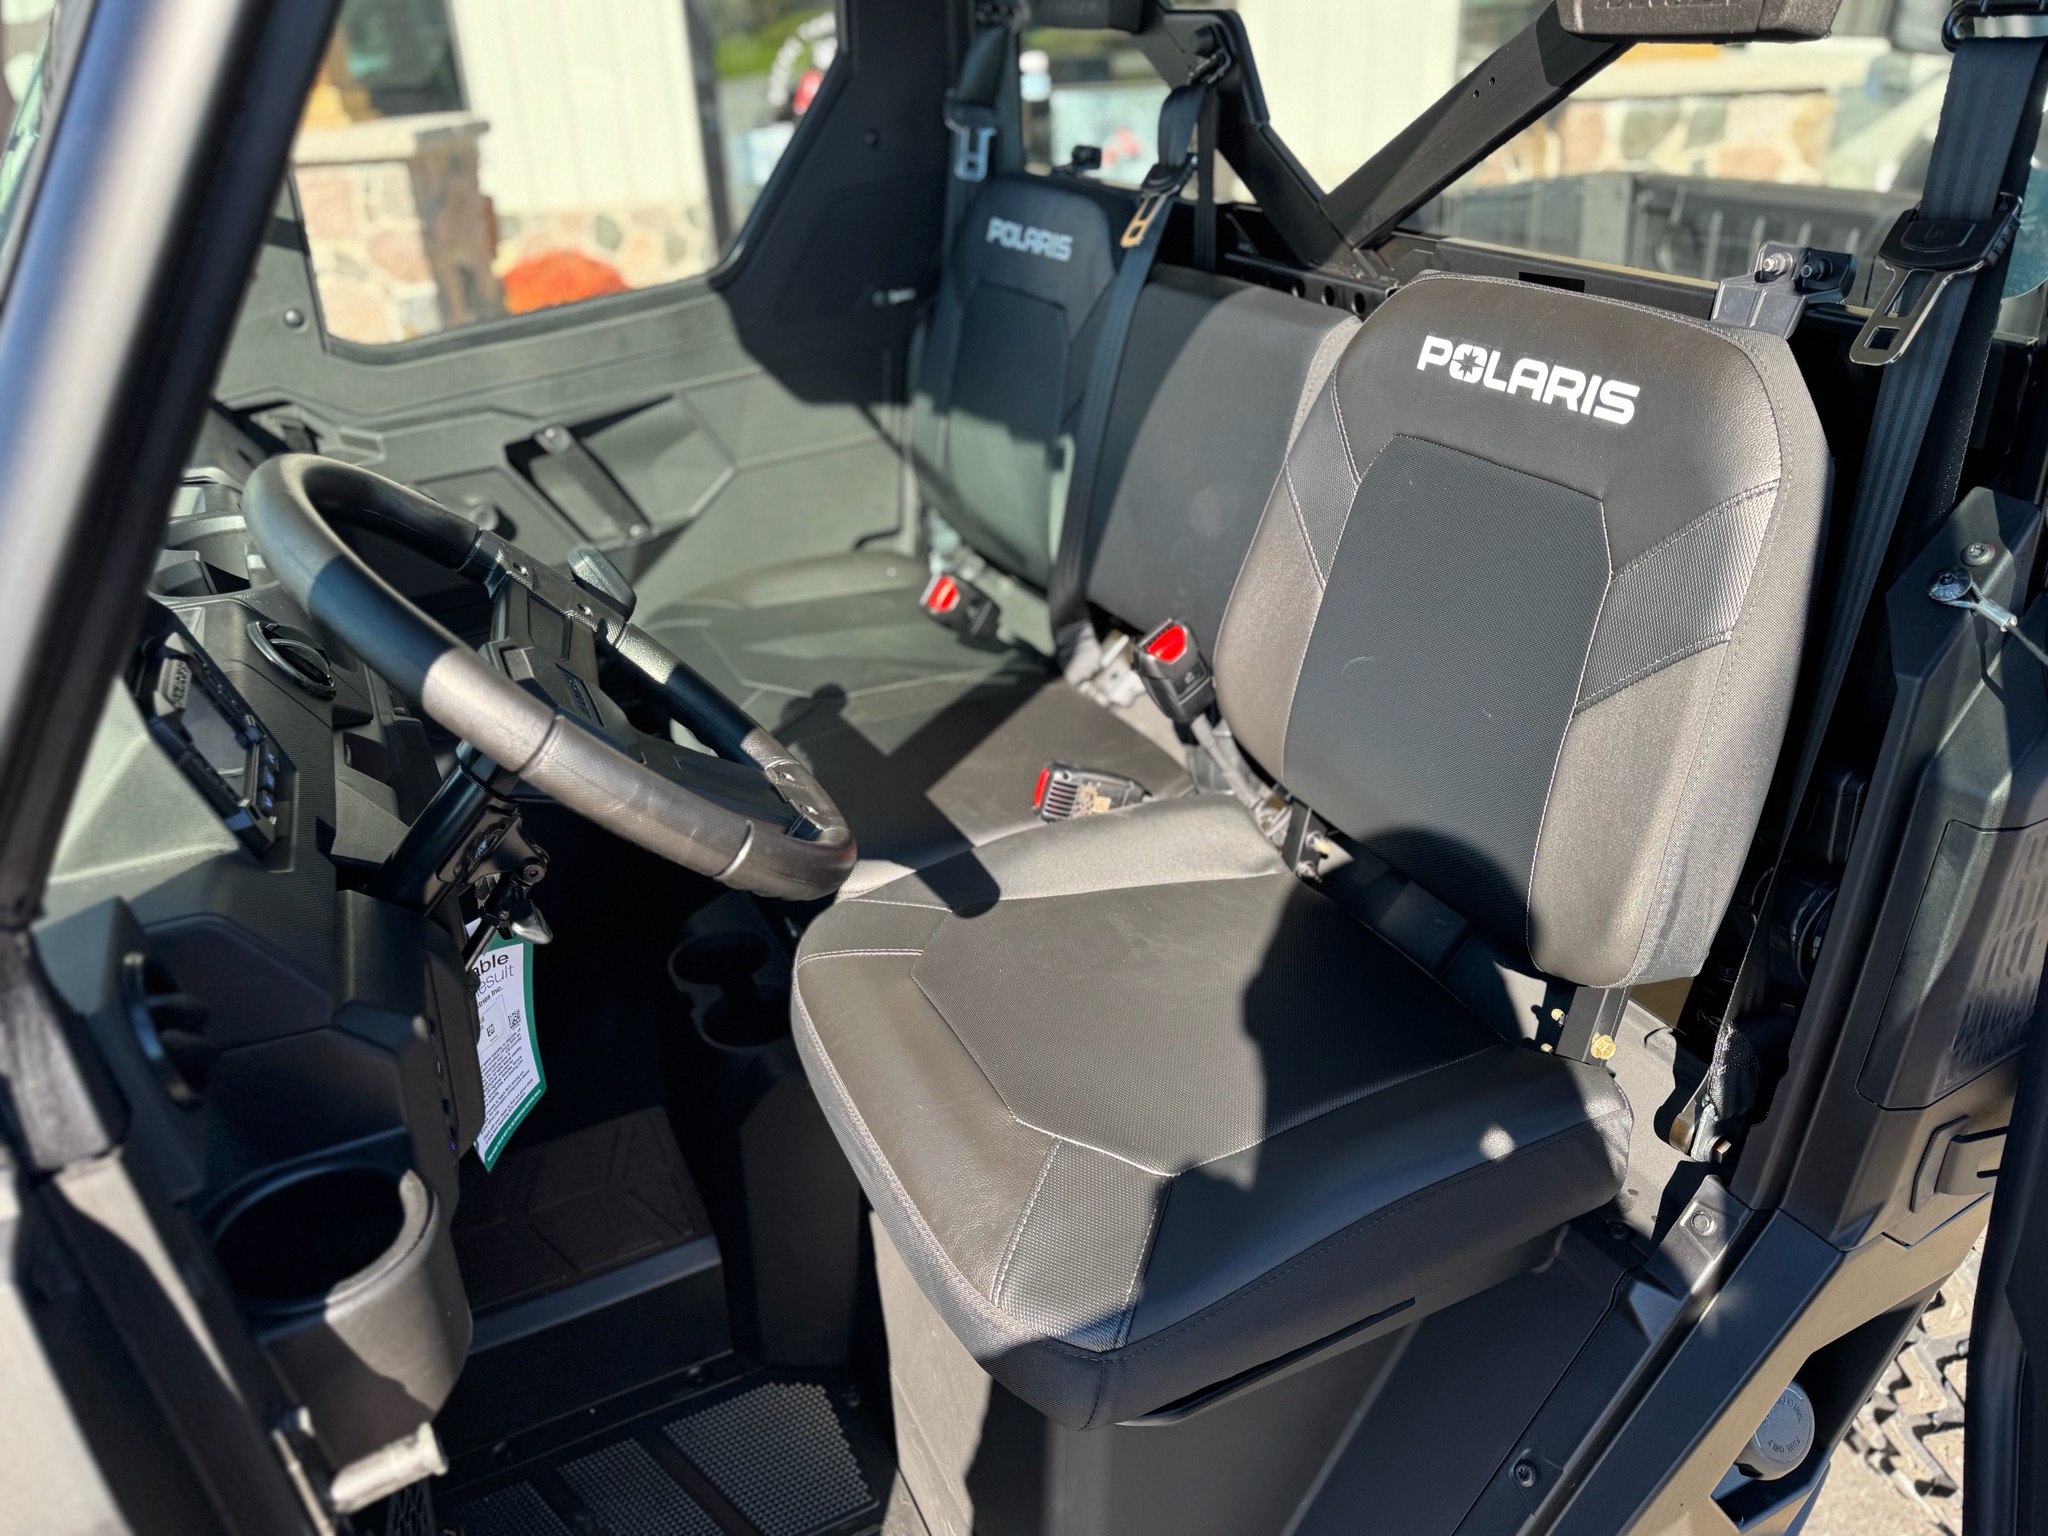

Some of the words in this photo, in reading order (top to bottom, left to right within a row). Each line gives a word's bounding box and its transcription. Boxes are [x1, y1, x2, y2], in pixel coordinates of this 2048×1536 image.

[986, 216, 1074, 262] POLARIS
[1416, 334, 1641, 425] POLARIS
[472, 954, 509, 977] able
